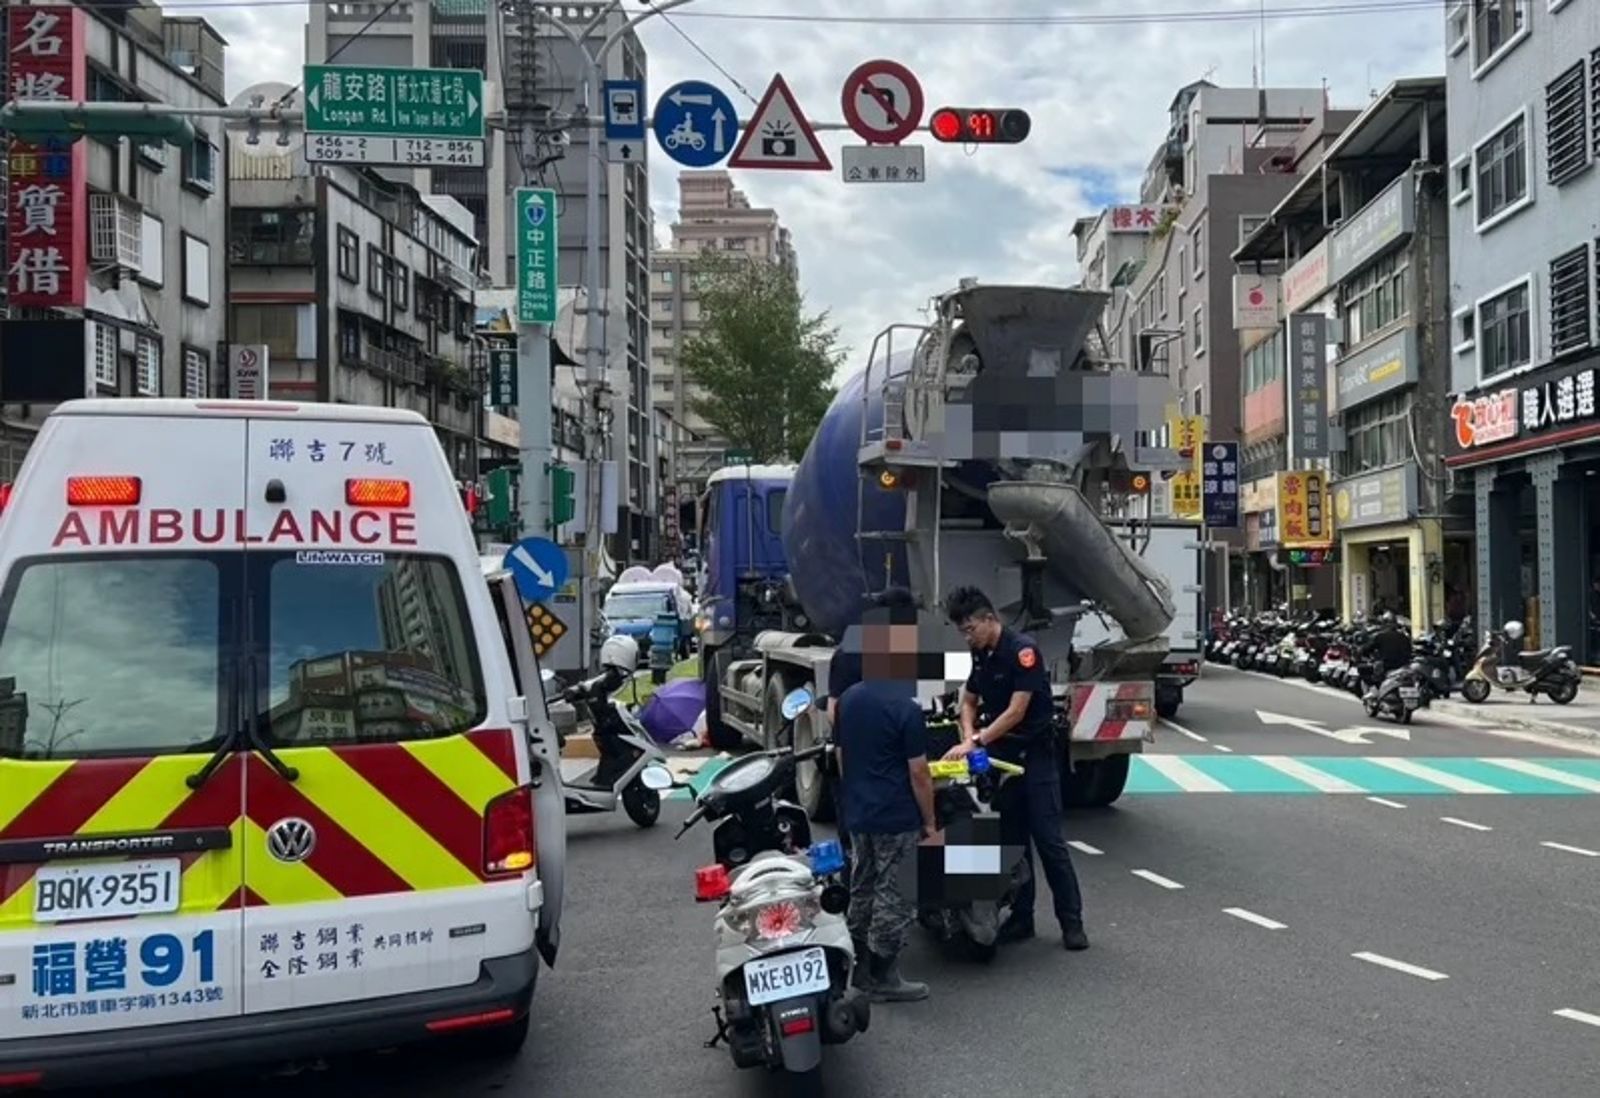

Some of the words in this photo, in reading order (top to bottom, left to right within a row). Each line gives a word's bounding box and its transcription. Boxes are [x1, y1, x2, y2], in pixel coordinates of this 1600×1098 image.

[322, 72, 387, 102] 龍安路
[322, 107, 364, 127] Longan
[849, 166, 920, 180] 公車除外
[9, 184, 69, 296] 質借
[526, 228, 547, 290] 中正路
[269, 438, 393, 466] 聯吉7號
[53, 508, 418, 547] AMBULANCE
[43, 836, 174, 854] TRANSPORTER
[37, 870, 172, 912] BQK-9351
[33, 929, 214, 997] 福營91
